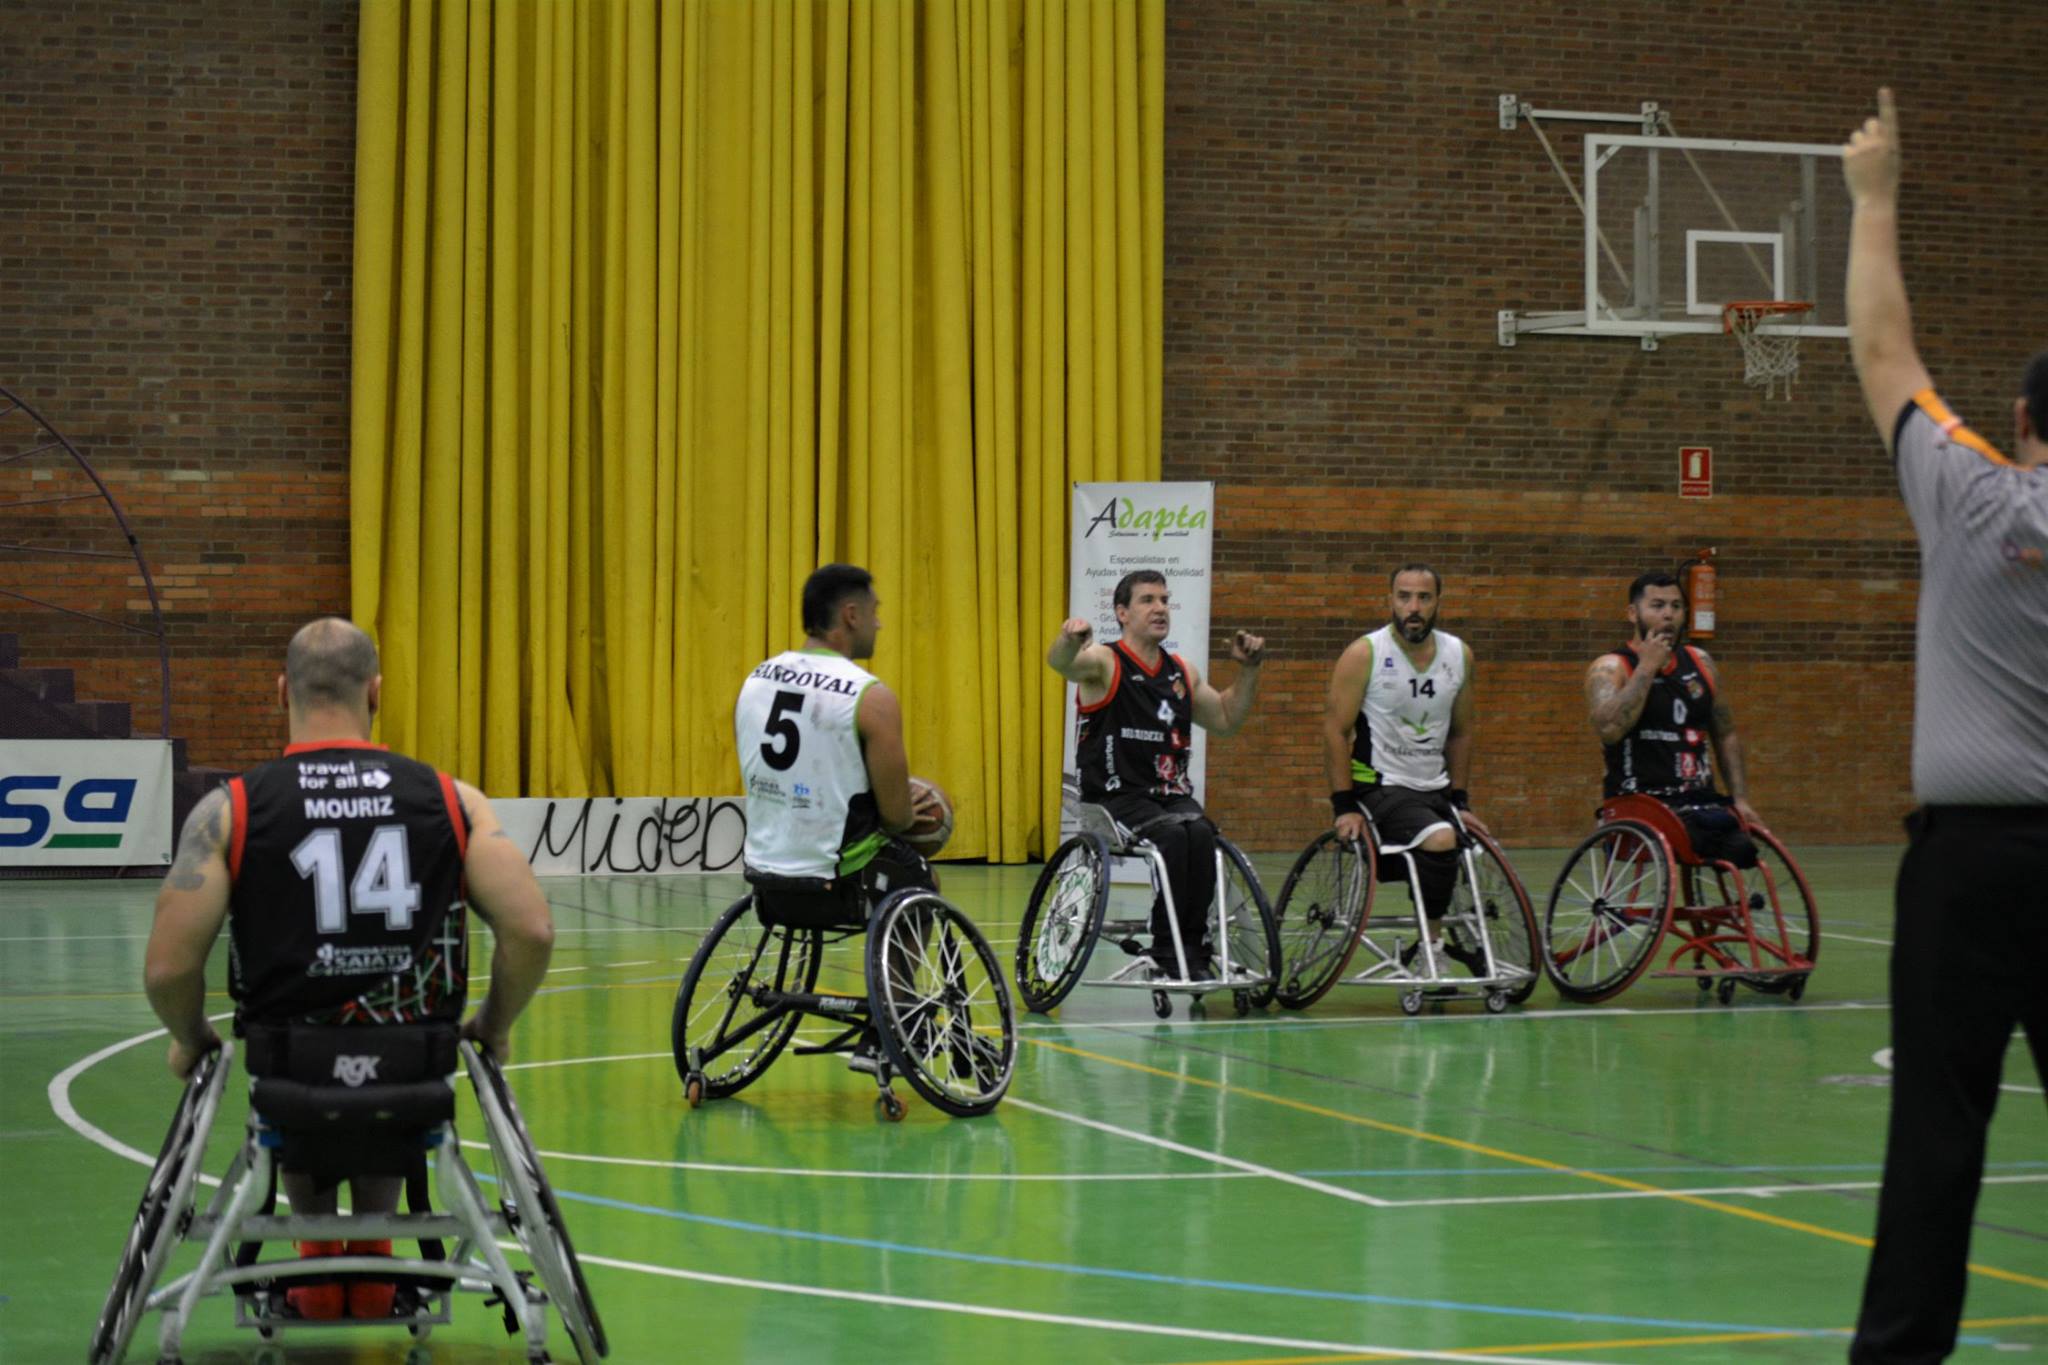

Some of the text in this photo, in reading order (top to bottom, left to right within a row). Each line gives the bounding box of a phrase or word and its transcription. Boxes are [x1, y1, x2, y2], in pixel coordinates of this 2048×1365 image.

[1085, 497, 1207, 542] Adapta
[1110, 555, 1166, 565] Especialistas
[1085, 568, 1118, 578] Ayudas
[1165, 568, 1204, 577] Movilidad
[1409, 679, 1435, 698] 14
[1157, 700, 1175, 725] 4
[760, 690, 805, 771] 5
[299, 761, 356, 775] travel
[299, 774, 358, 790] for all
[304, 796, 395, 819] MOURIZ
[289, 824, 421, 934] 14
